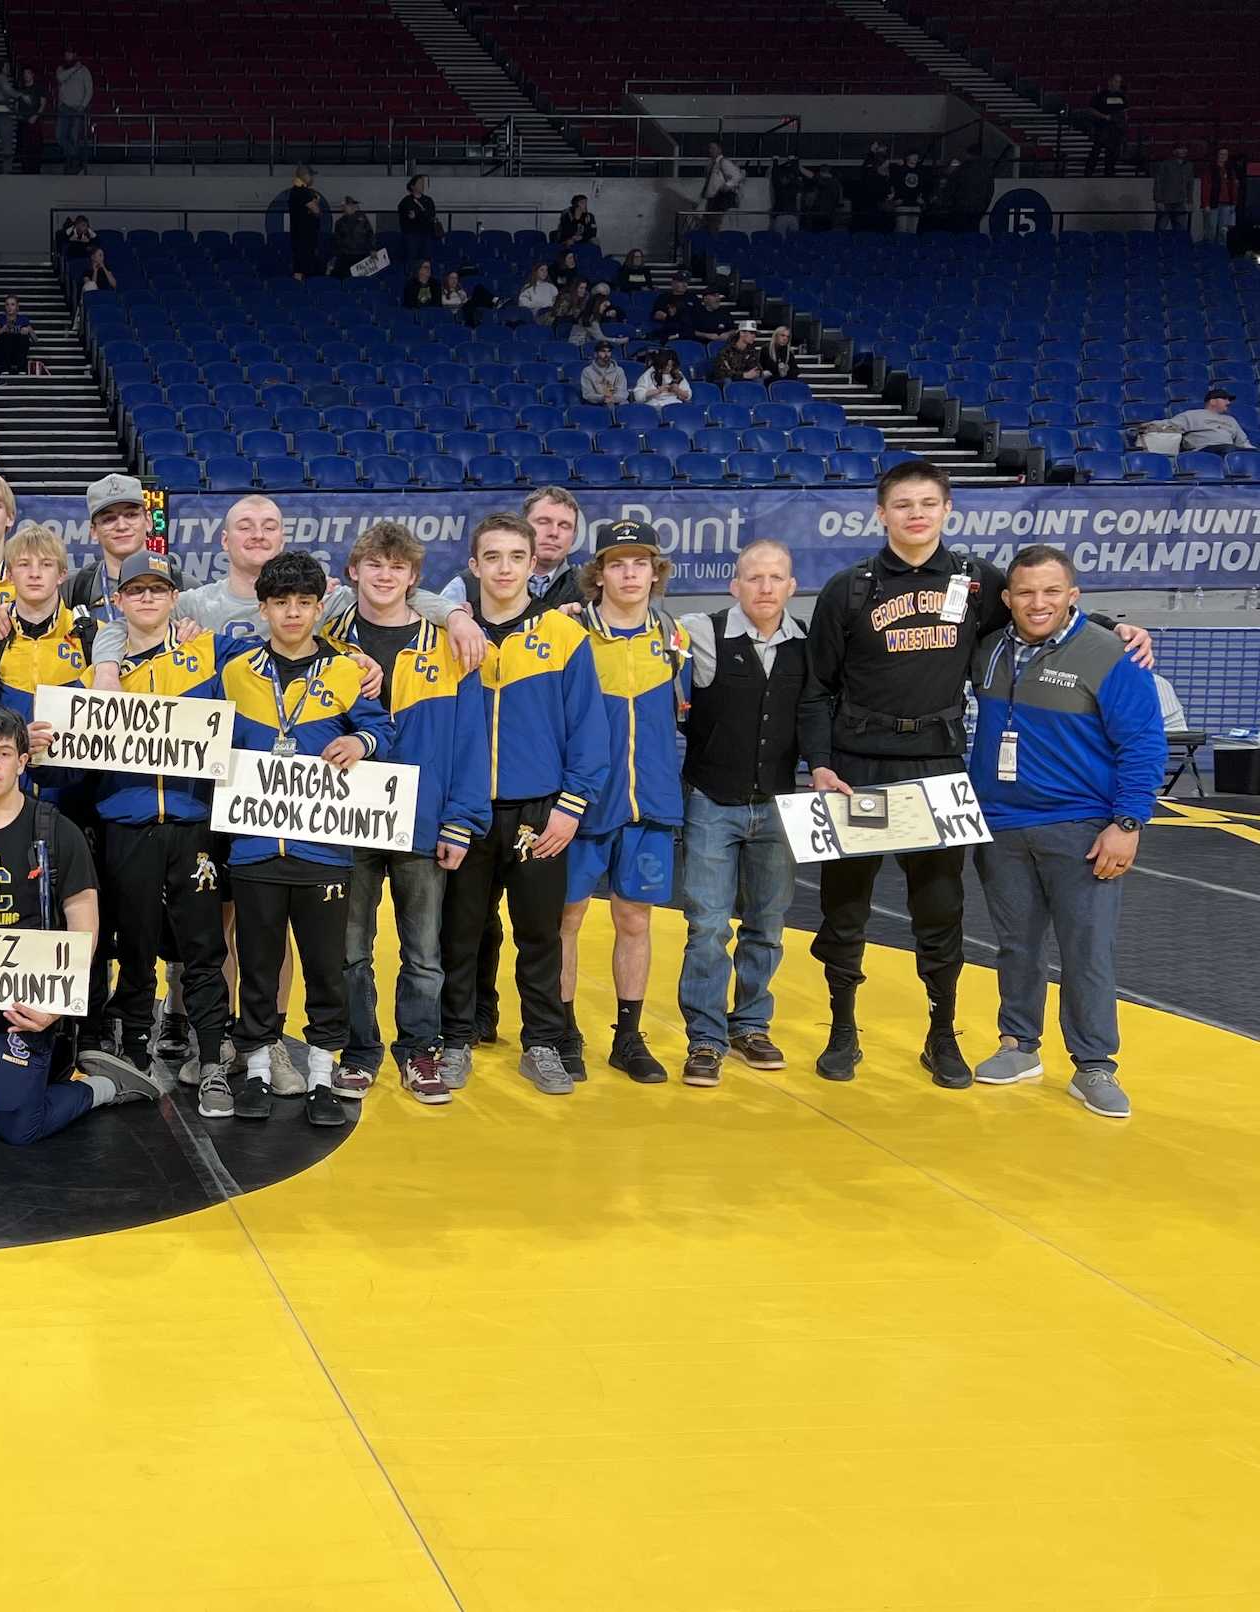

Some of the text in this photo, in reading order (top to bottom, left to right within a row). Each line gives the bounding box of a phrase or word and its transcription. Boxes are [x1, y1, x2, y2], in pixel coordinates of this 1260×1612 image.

[1008, 207, 1037, 238] 15
[281, 517, 349, 543] EDIT
[820, 510, 884, 537] OSA
[942, 510, 1089, 537] ONPOINT
[871, 592, 917, 631] CROOK
[917, 590, 947, 614] COU
[524, 635, 550, 659] CC
[885, 625, 958, 652] WRESTLING
[57, 643, 81, 669] CC
[171, 650, 198, 672] CC
[414, 655, 439, 682] CC
[309, 679, 334, 707] CC
[69, 694, 221, 738] PROVOST 9
[47, 731, 209, 771] CROOK COUNTY
[256, 758, 398, 805] VARGAS 9
[950, 781, 975, 807] 12
[228, 794, 398, 842] CROOK COUNTY
[935, 811, 984, 840] NTY
[55, 941, 70, 970] 11
